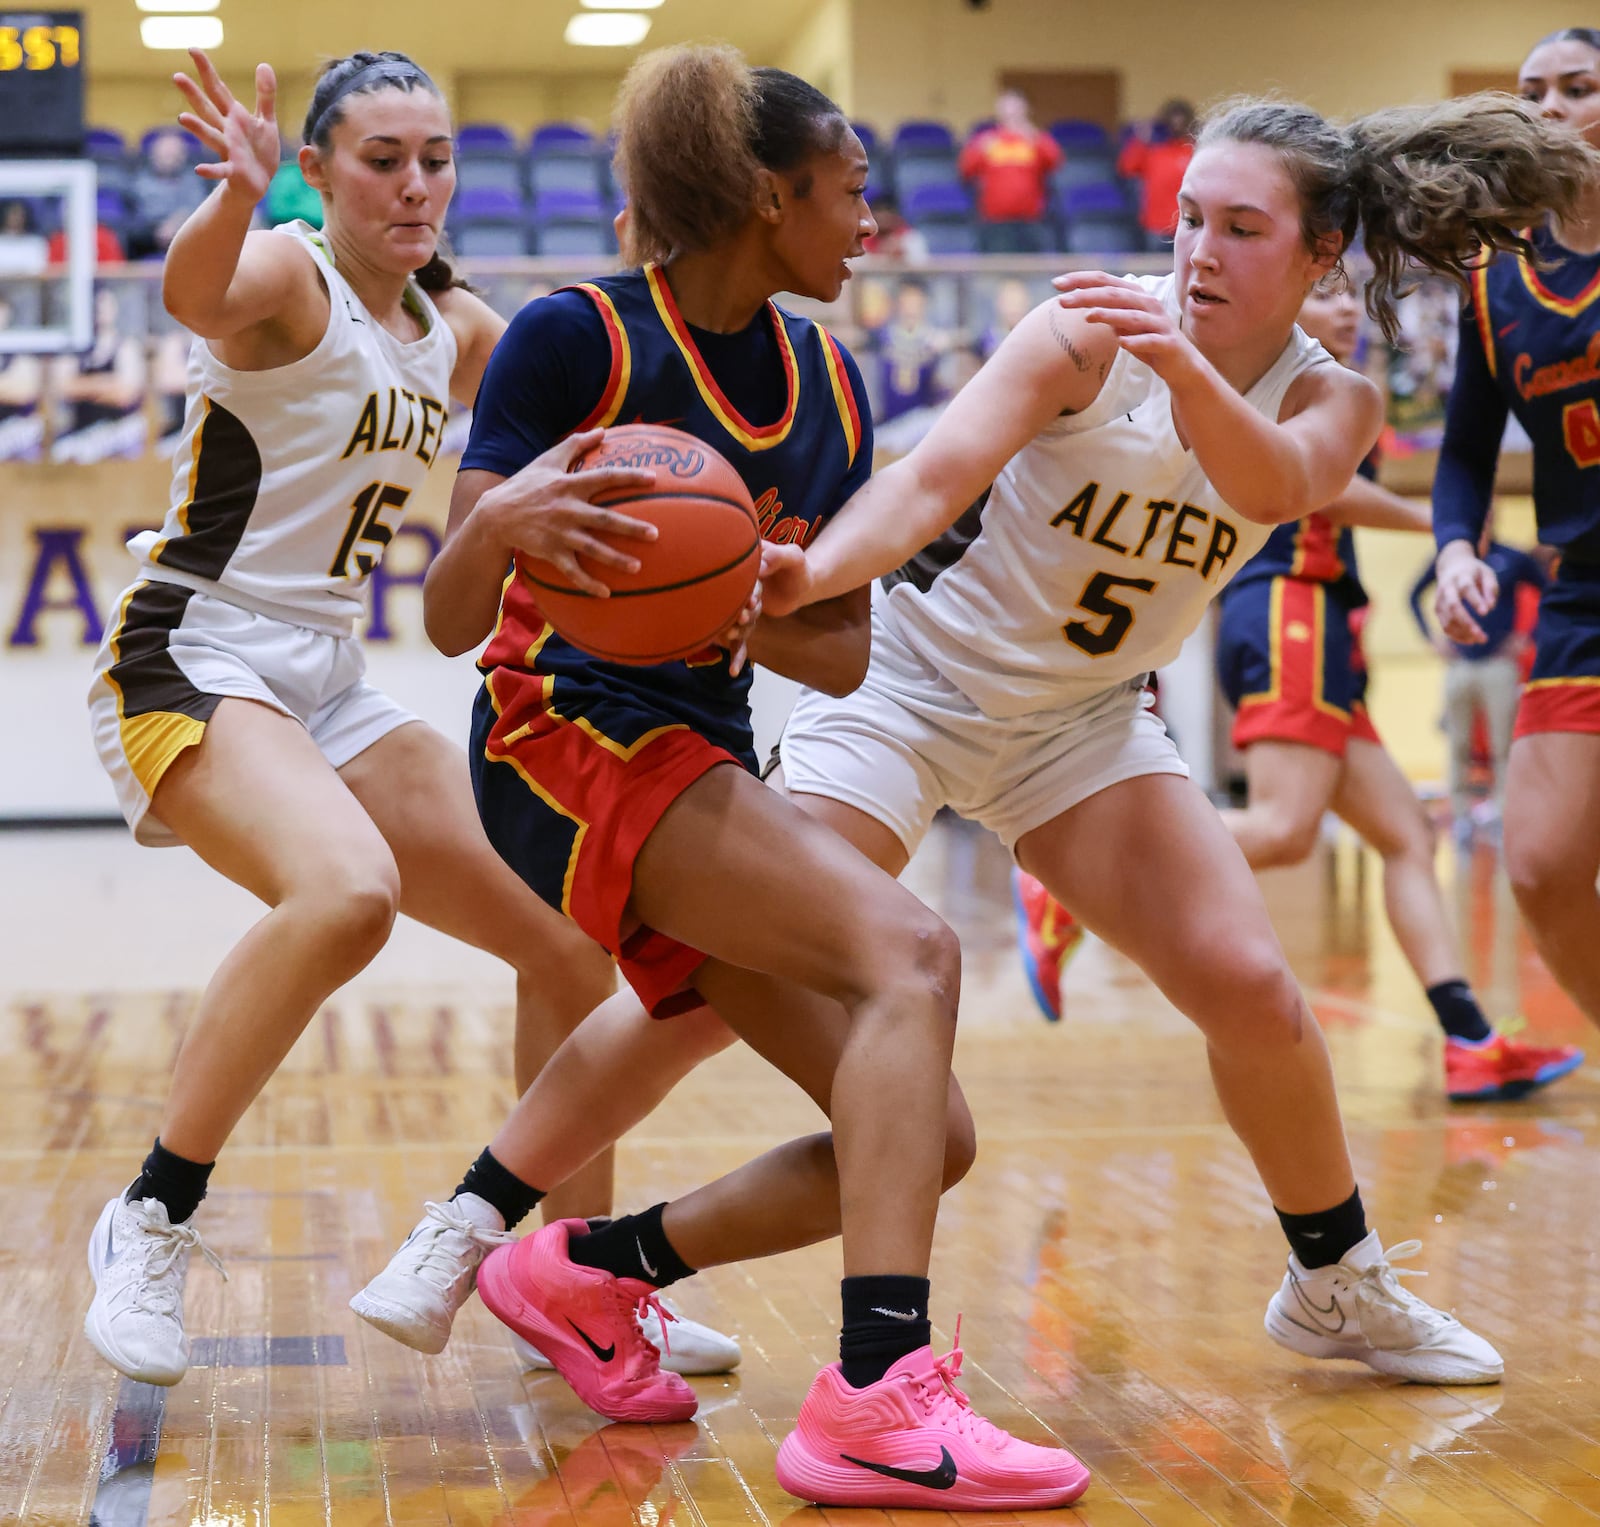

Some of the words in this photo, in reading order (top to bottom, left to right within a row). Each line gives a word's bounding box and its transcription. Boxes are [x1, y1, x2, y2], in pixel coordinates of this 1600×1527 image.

[338, 386, 448, 470] ALTE
[328, 479, 413, 581] 15
[1049, 480, 1238, 585] ALTER
[1061, 569, 1160, 660] 5
